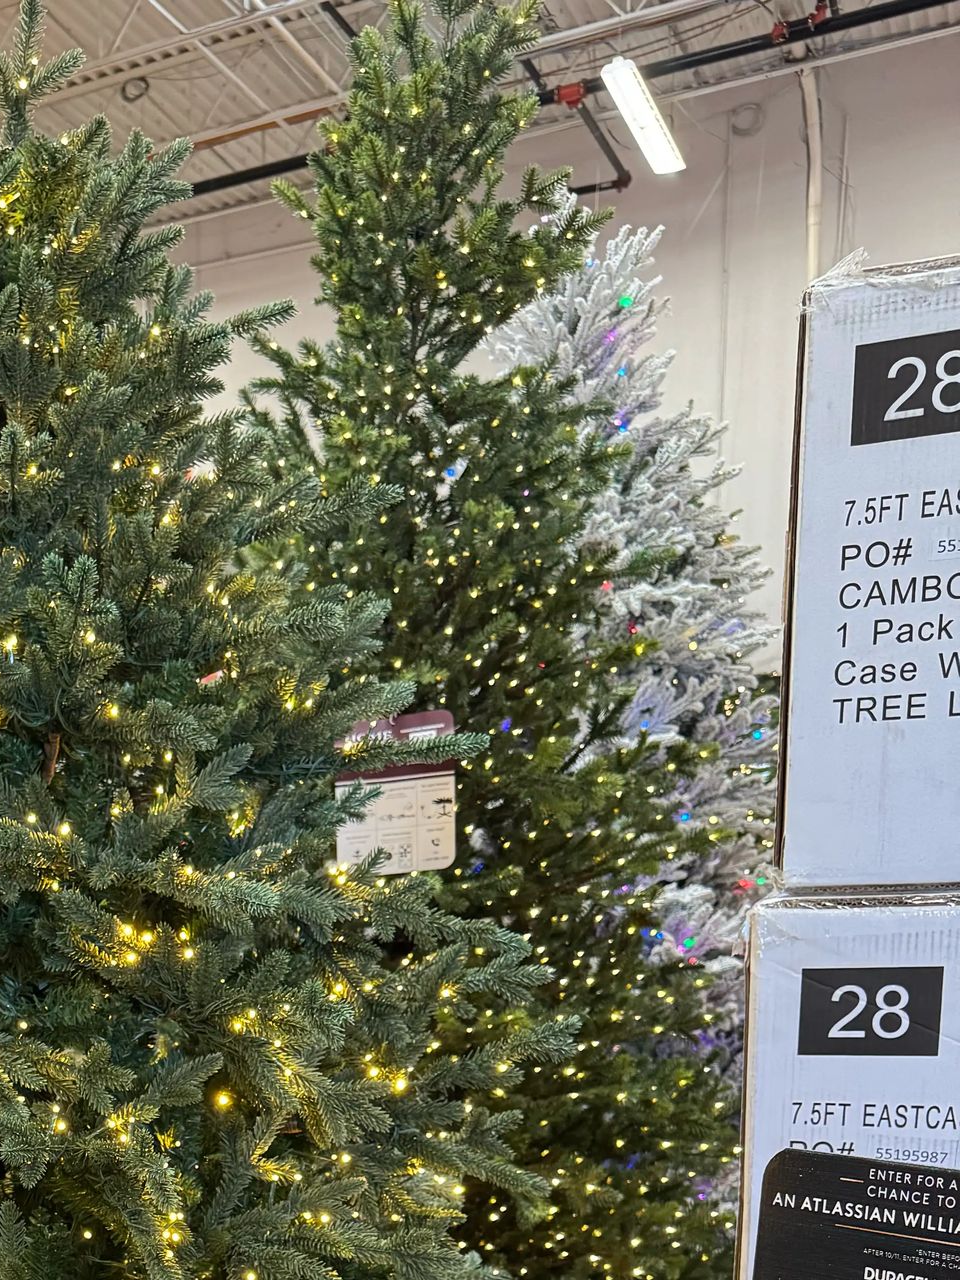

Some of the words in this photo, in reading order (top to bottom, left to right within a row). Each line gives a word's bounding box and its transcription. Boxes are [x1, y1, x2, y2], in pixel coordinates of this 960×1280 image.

[883, 349, 960, 422] 28
[844, 493, 909, 527] 7.5FT
[921, 488, 960, 519] EA
[840, 537, 913, 571] PO#
[837, 622, 848, 648] 1
[872, 613, 954, 646] Pack
[834, 660, 918, 686] Case
[832, 692, 927, 724] TREE
[827, 984, 910, 1039] 28
[791, 1101, 852, 1127] 7.5FT
[862, 1103, 960, 1130] EASTCA
[874, 1147, 948, 1165] 55195987
[869, 1168, 912, 1185] ENTER
[916, 1174, 945, 1189] FOR
[948, 1179, 958, 1191] A
[772, 1192, 796, 1209] AN
[801, 1197, 896, 1225] ATLASSIAN
[866, 1185, 931, 1206] CHANCE
[936, 1195, 957, 1209] TO
[863, 1247, 884, 1257] AFTER
[902, 1254, 925, 1265] ENTER
[926, 1259, 940, 1267] FOR
